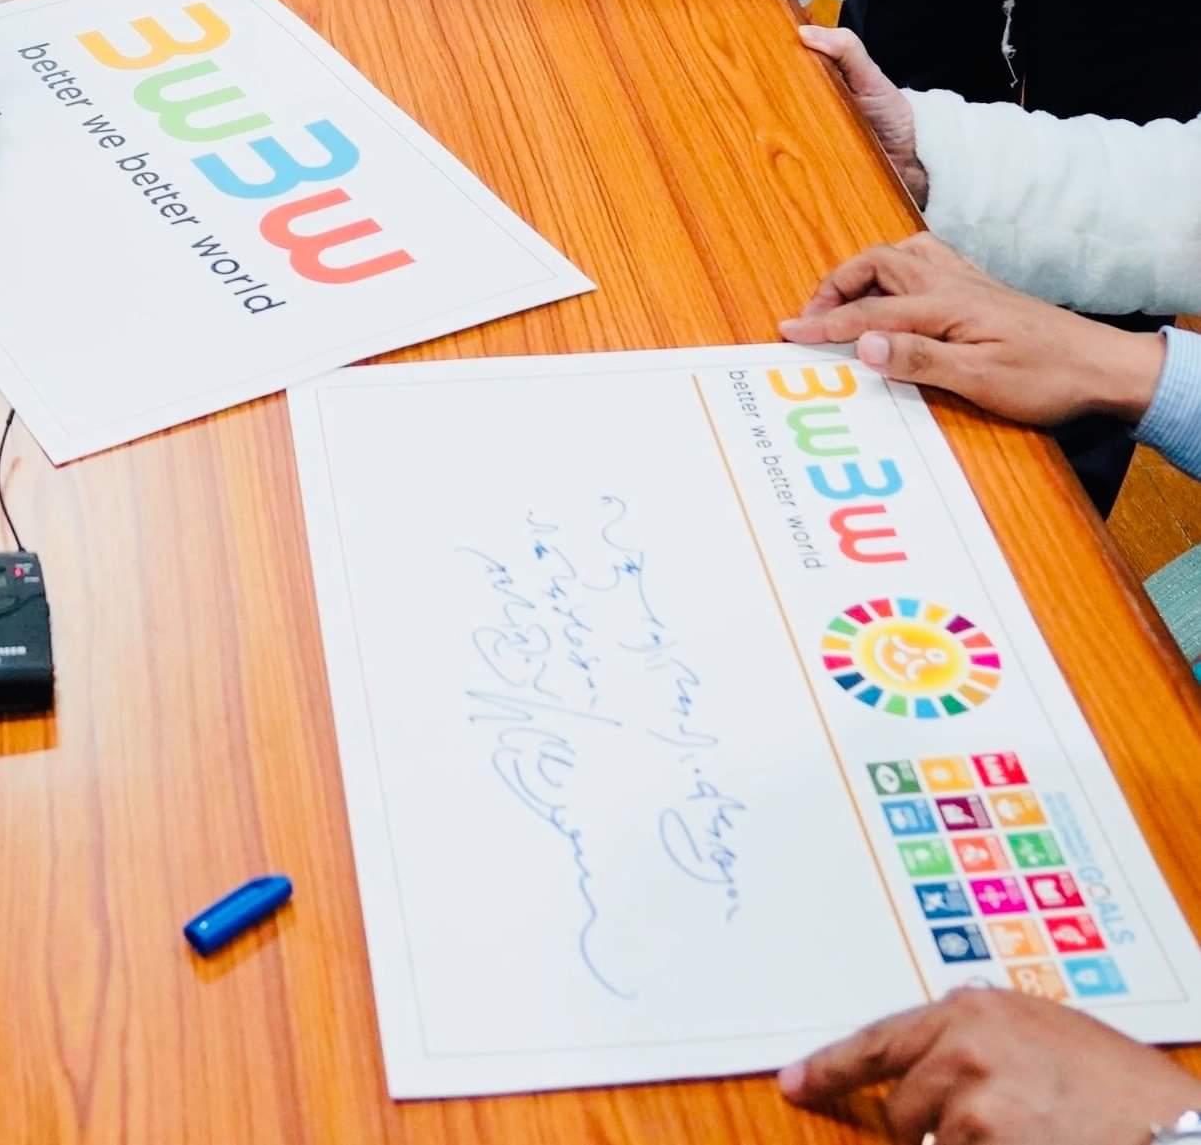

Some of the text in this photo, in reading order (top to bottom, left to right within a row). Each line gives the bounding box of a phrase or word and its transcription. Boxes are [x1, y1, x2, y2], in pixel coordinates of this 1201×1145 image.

[17, 42, 287, 314] better we better world
[729, 369, 826, 569] better we better world
